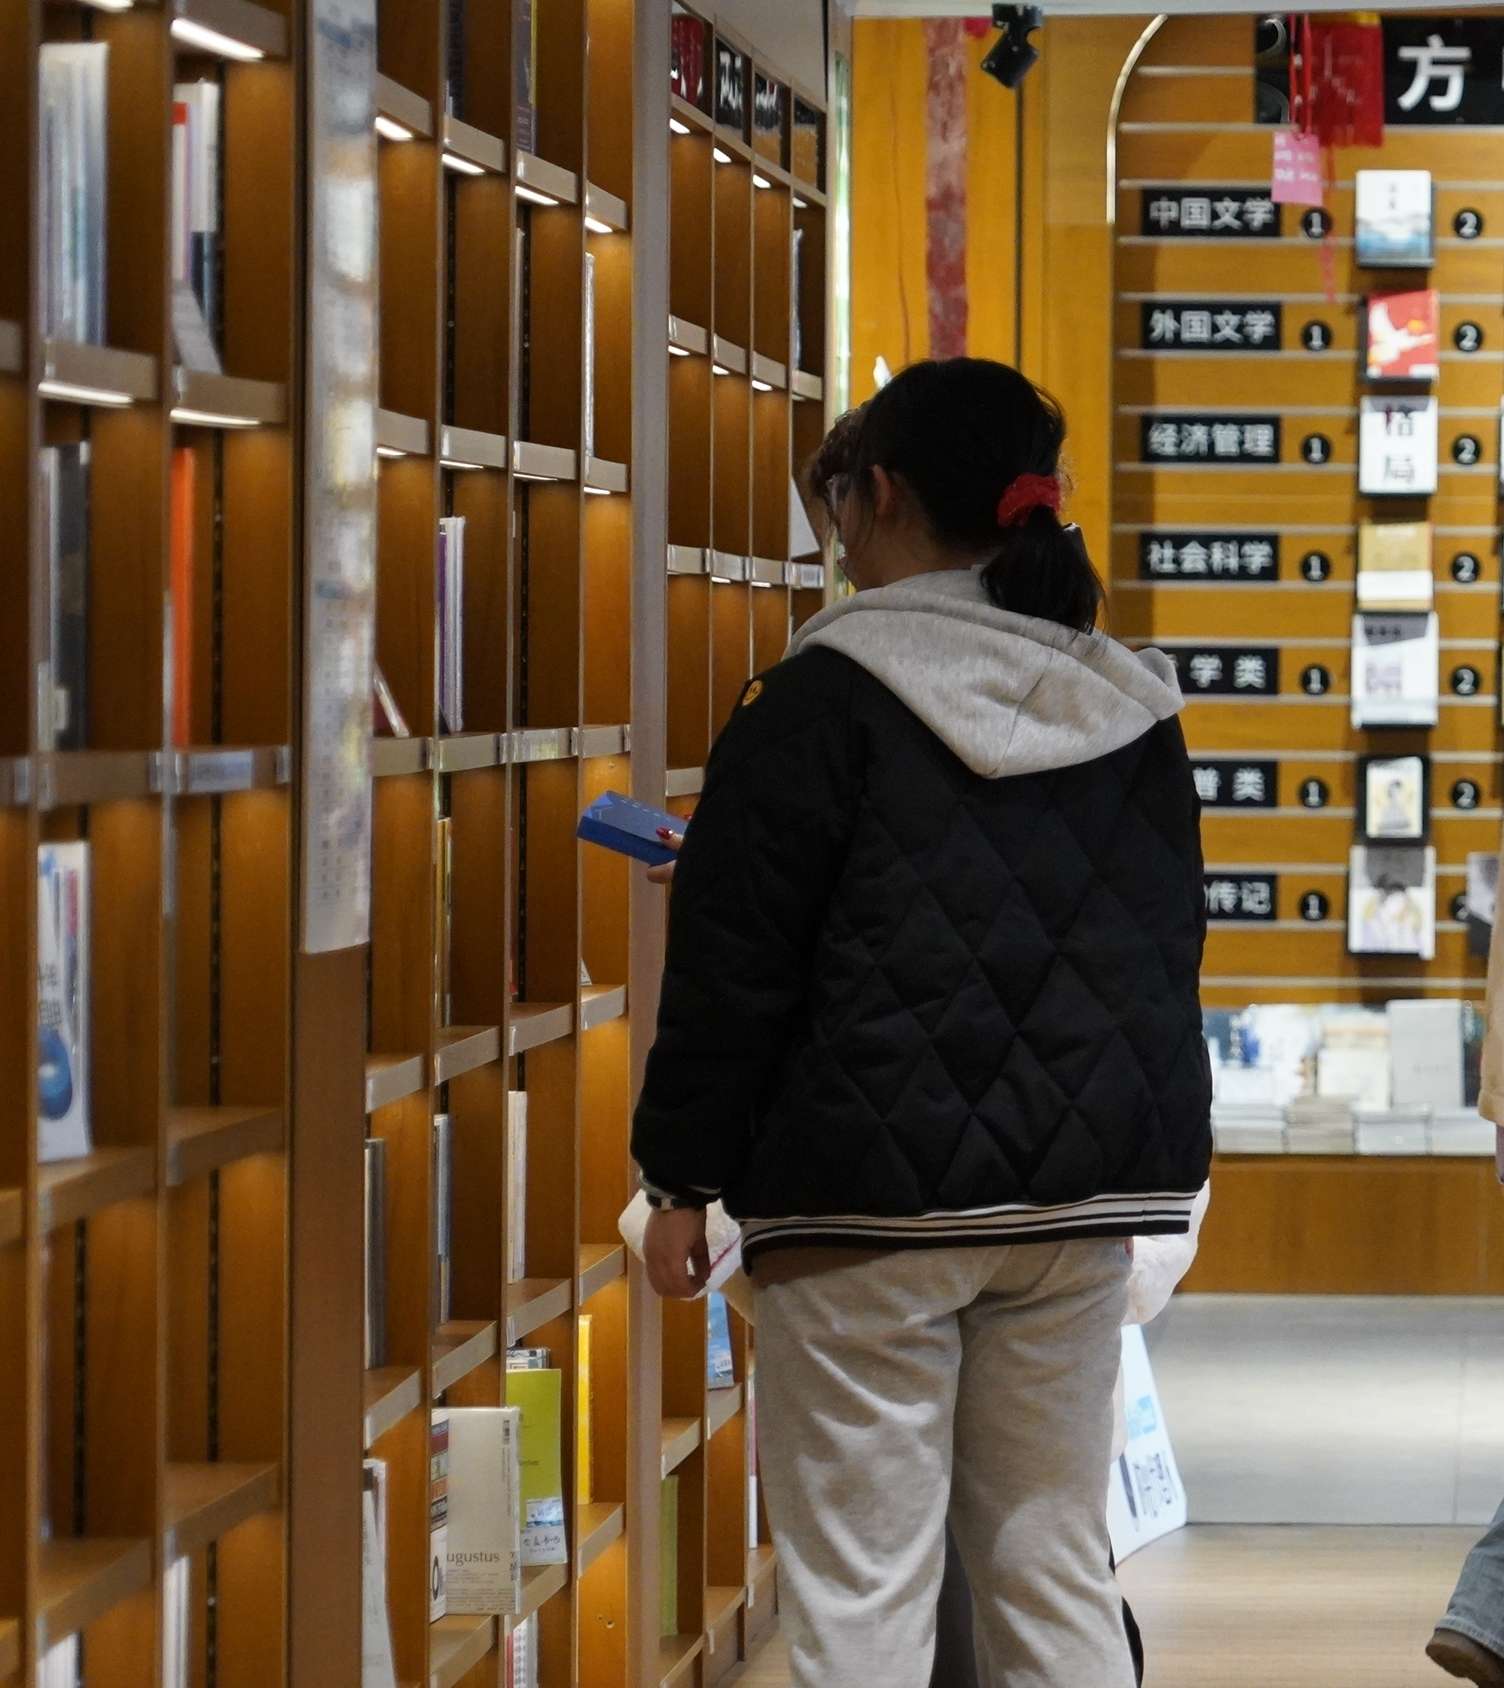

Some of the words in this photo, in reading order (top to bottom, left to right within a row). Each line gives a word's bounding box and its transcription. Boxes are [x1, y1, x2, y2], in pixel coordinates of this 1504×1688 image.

[1149, 196, 1275, 232] 中国文学
[1309, 213, 1324, 237] 1
[1460, 213, 1476, 236] 2
[1149, 310, 1276, 345] 外国文学
[1309, 326, 1324, 351] 1
[1460, 325, 1476, 350] 2
[1149, 423, 1275, 457] 经济管理
[1309, 438, 1324, 463] 1
[1459, 438, 1475, 462] 2
[1147, 539, 1274, 575] 社会科学
[1309, 556, 1322, 580] 1
[1458, 556, 1473, 581] 2
[1169, 654, 1267, 689] 学类
[1309, 669, 1322, 694] 1
[1458, 669, 1473, 693] 2
[1307, 782, 1320, 807] 1
[1458, 783, 1474, 807] 2
[1204, 879, 1271, 915] 传记
[1307, 895, 1320, 920] 1
